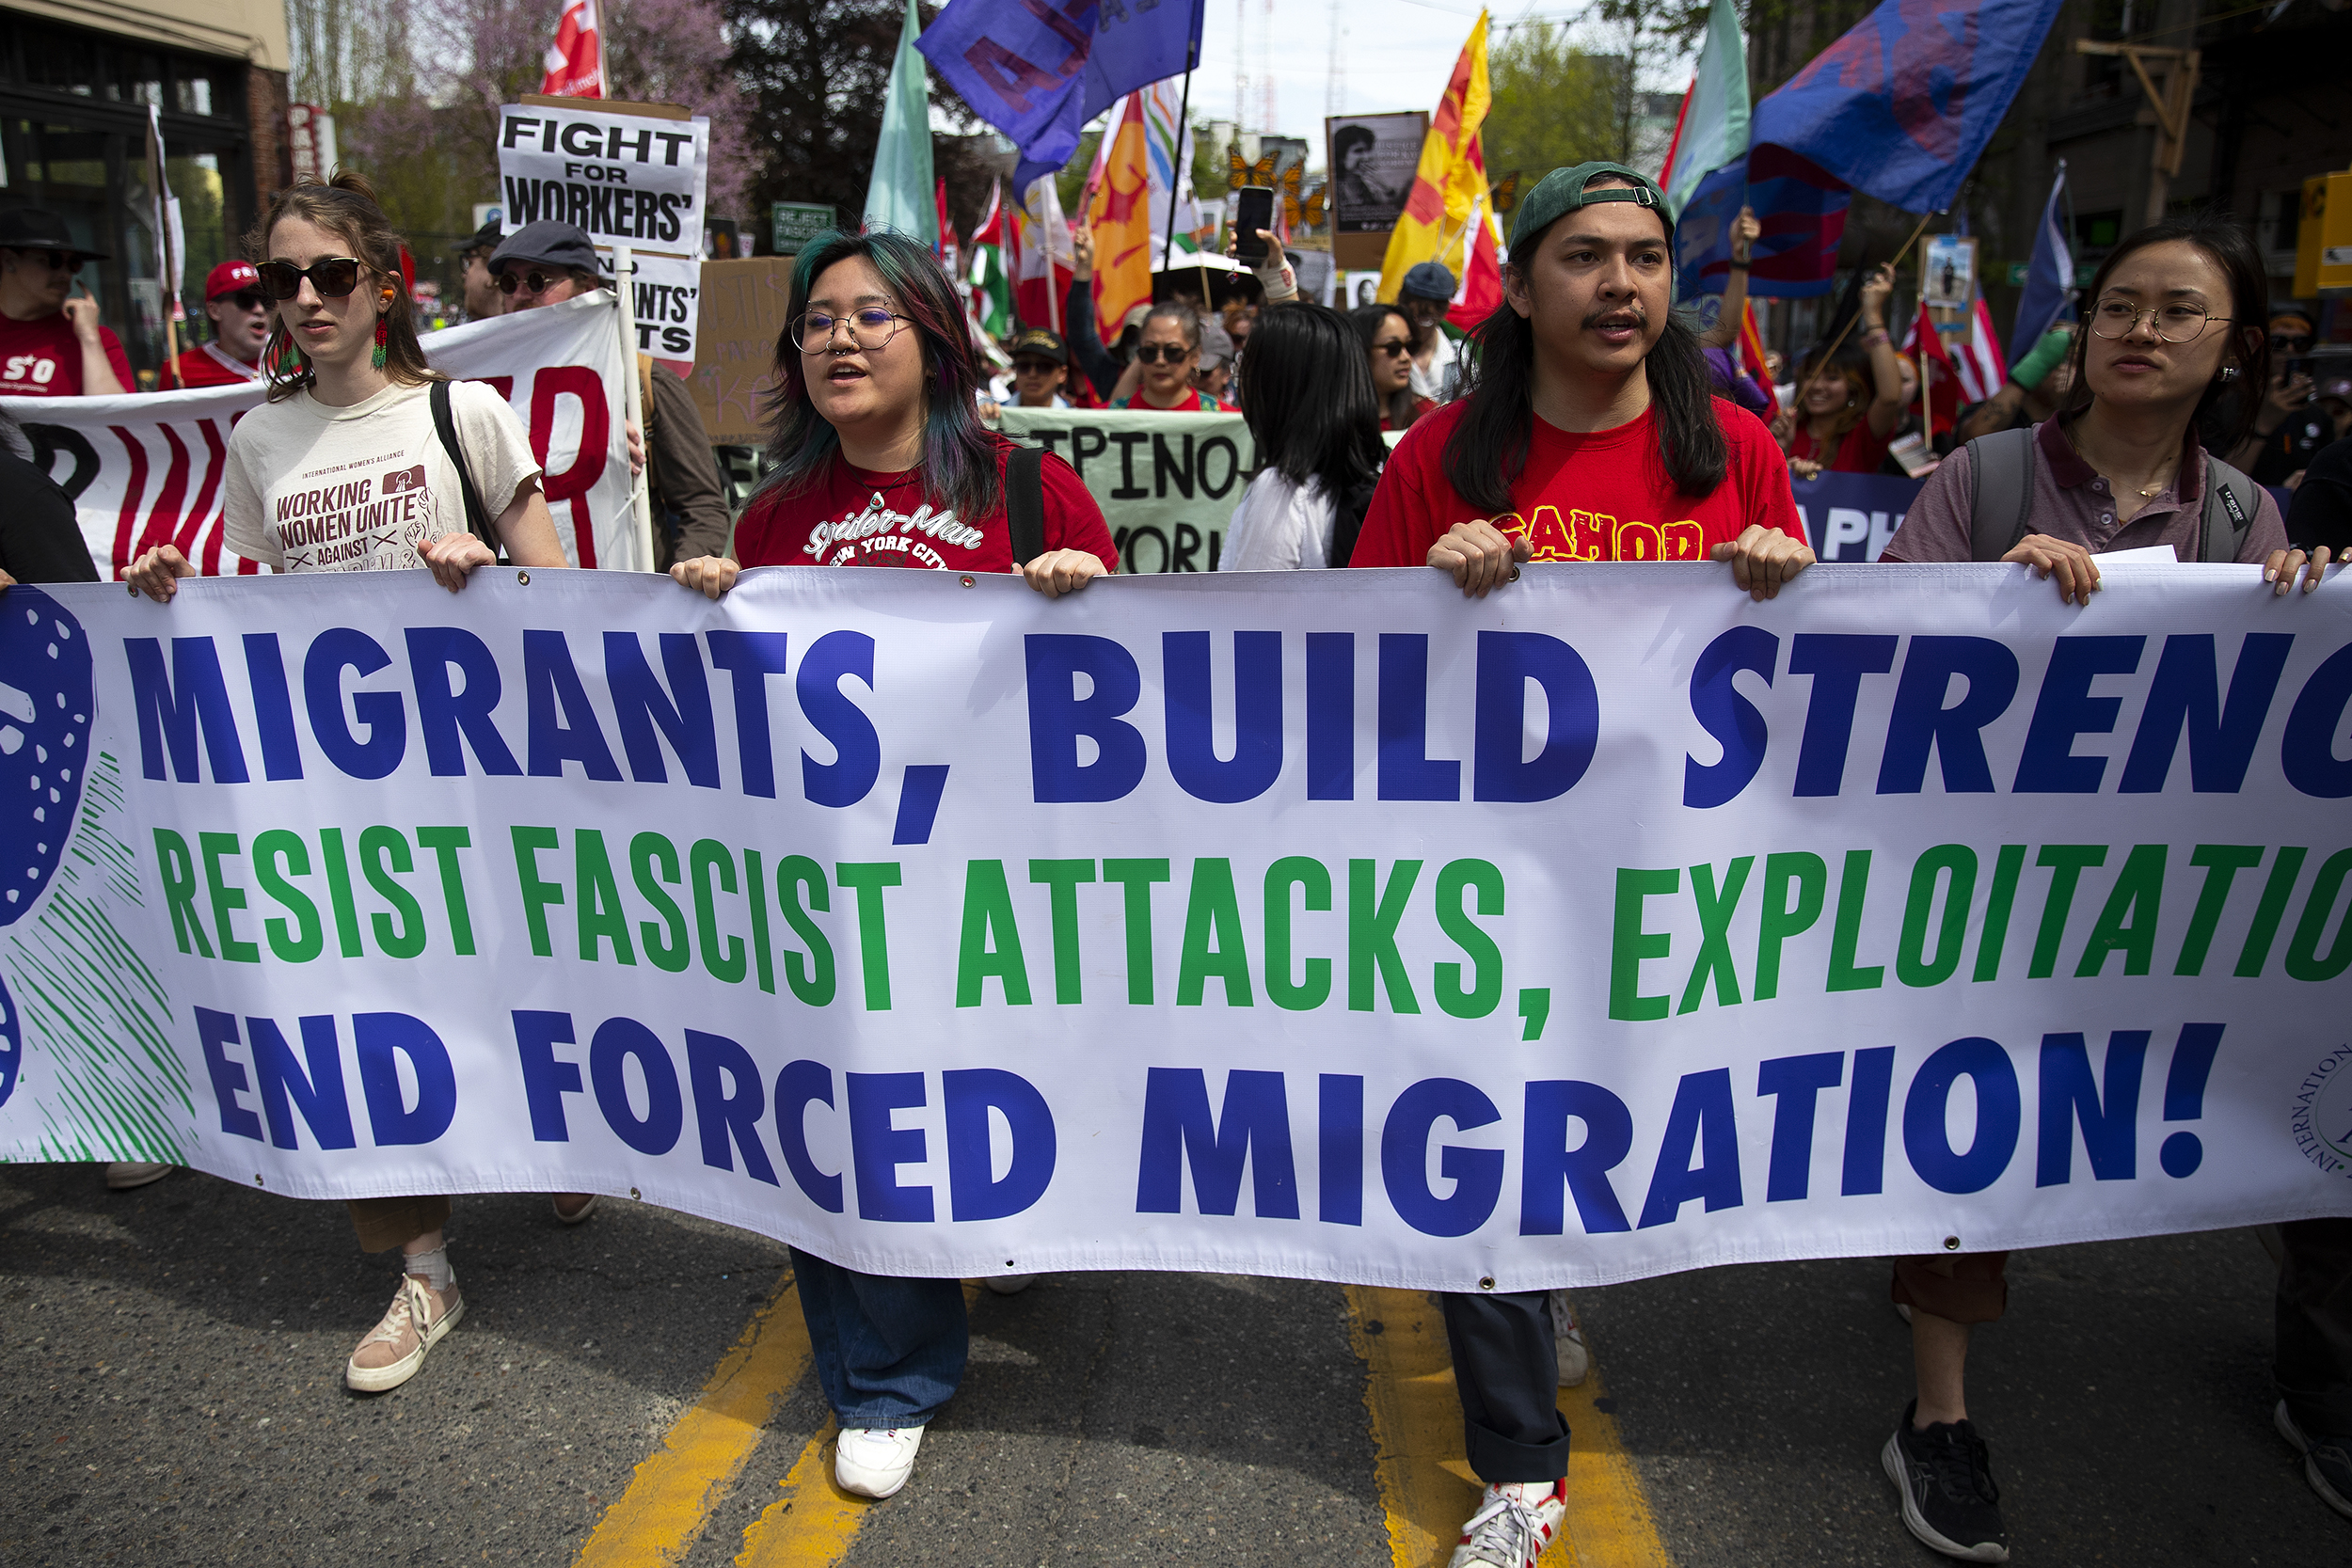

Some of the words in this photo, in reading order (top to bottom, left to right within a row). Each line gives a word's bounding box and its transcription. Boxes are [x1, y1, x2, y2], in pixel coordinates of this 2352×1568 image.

[503, 116, 692, 166] FIGHT
[565, 163, 628, 184] FOR
[505, 176, 692, 242] WORKERS'
[302, 465, 347, 479] INTERNATIONAL
[349, 457, 375, 469] WOMEN'S
[376, 450, 405, 464] ALLIANCE
[277, 479, 372, 522] WORKING
[277, 511, 352, 551] WOMEN
[357, 494, 417, 533] UNITE
[318, 537, 369, 565] AGAINST
[803, 503, 984, 562] Spider-Man
[861, 536, 913, 554] YORK
[123, 627, 950, 845] MIGRANTS,
[1025, 630, 1599, 803] BUILD
[152, 825, 476, 965] RESIST
[510, 824, 902, 1011] FASCIST
[956, 855, 1551, 1041] ATTACKS,
[1609, 843, 2352, 1022] EXPLOITATIO
[195, 1006, 456, 1151] END
[511, 1009, 1057, 1223] FORCED
[1136, 1022, 2227, 1238] MIGRATION!
